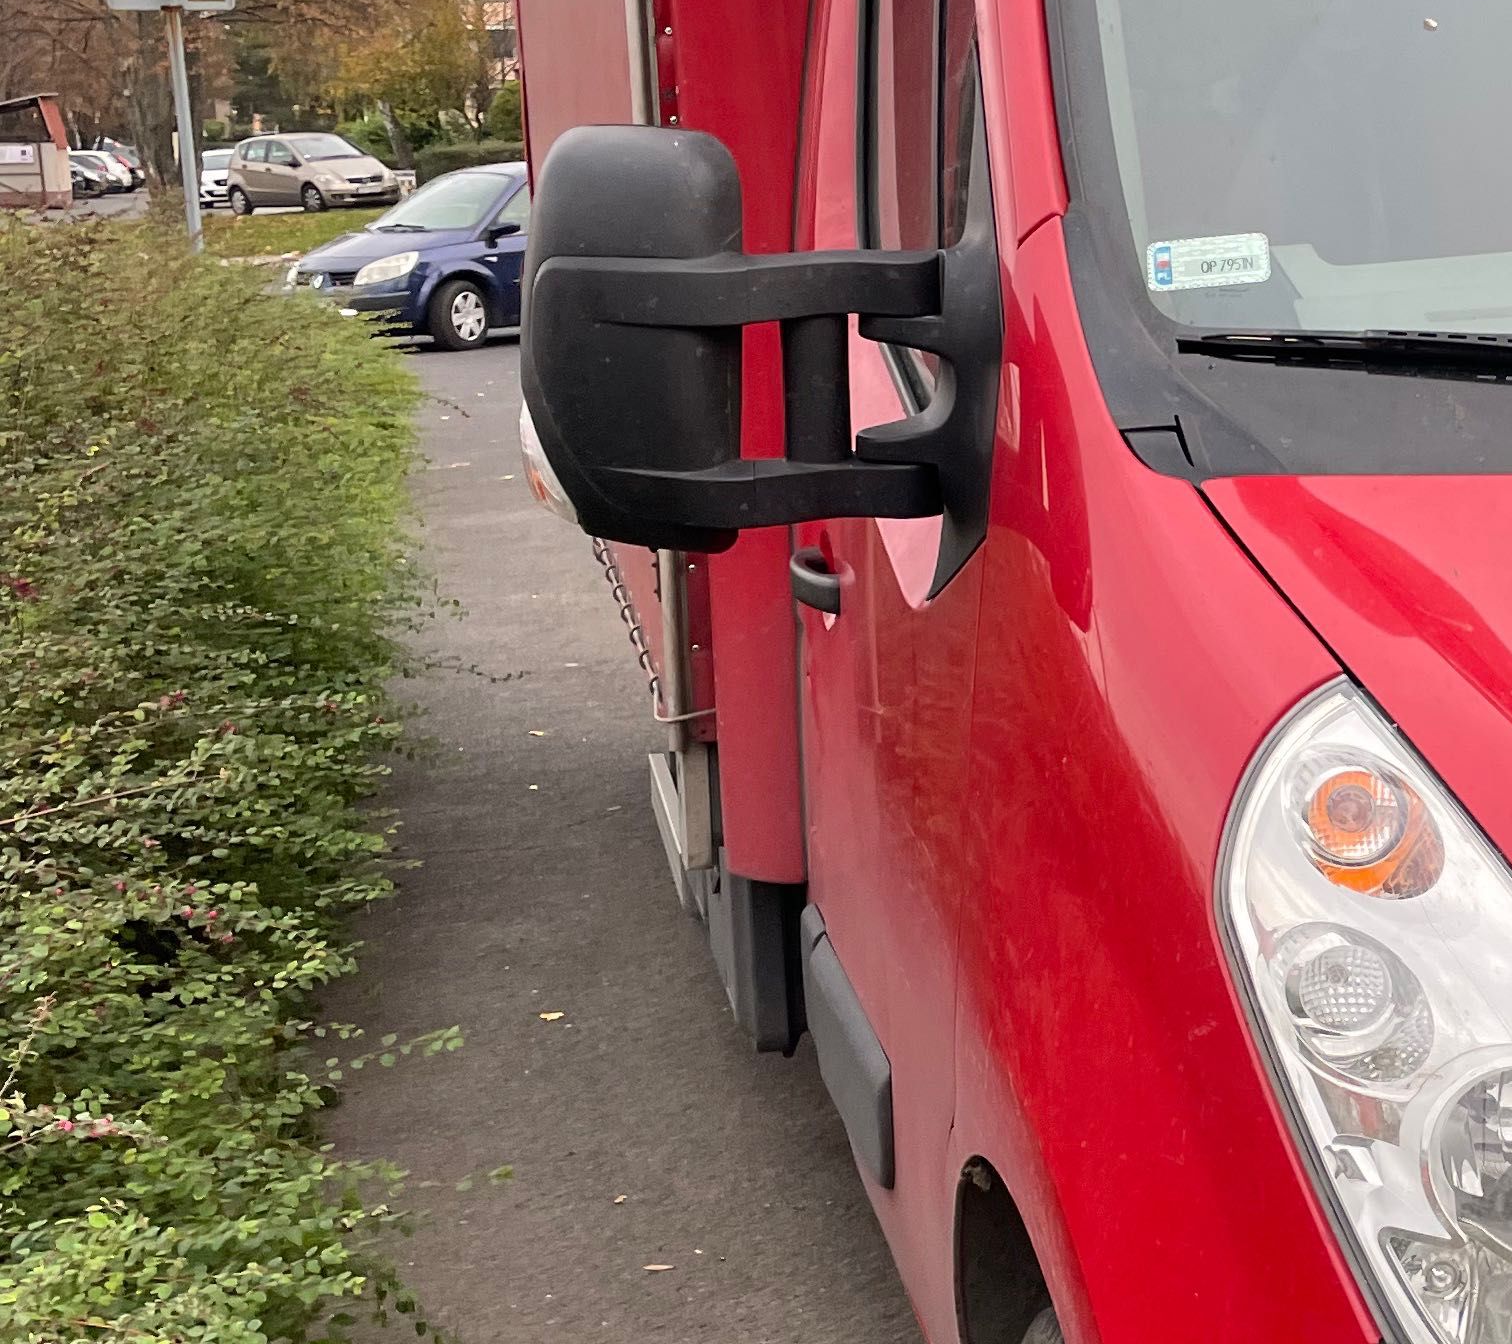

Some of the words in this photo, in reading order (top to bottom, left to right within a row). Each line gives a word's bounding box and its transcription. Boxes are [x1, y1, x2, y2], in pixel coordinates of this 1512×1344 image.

[1200, 260, 1217, 274] OP
[1219, 257, 1254, 272] 7951N
[1157, 272, 1171, 281] PL
